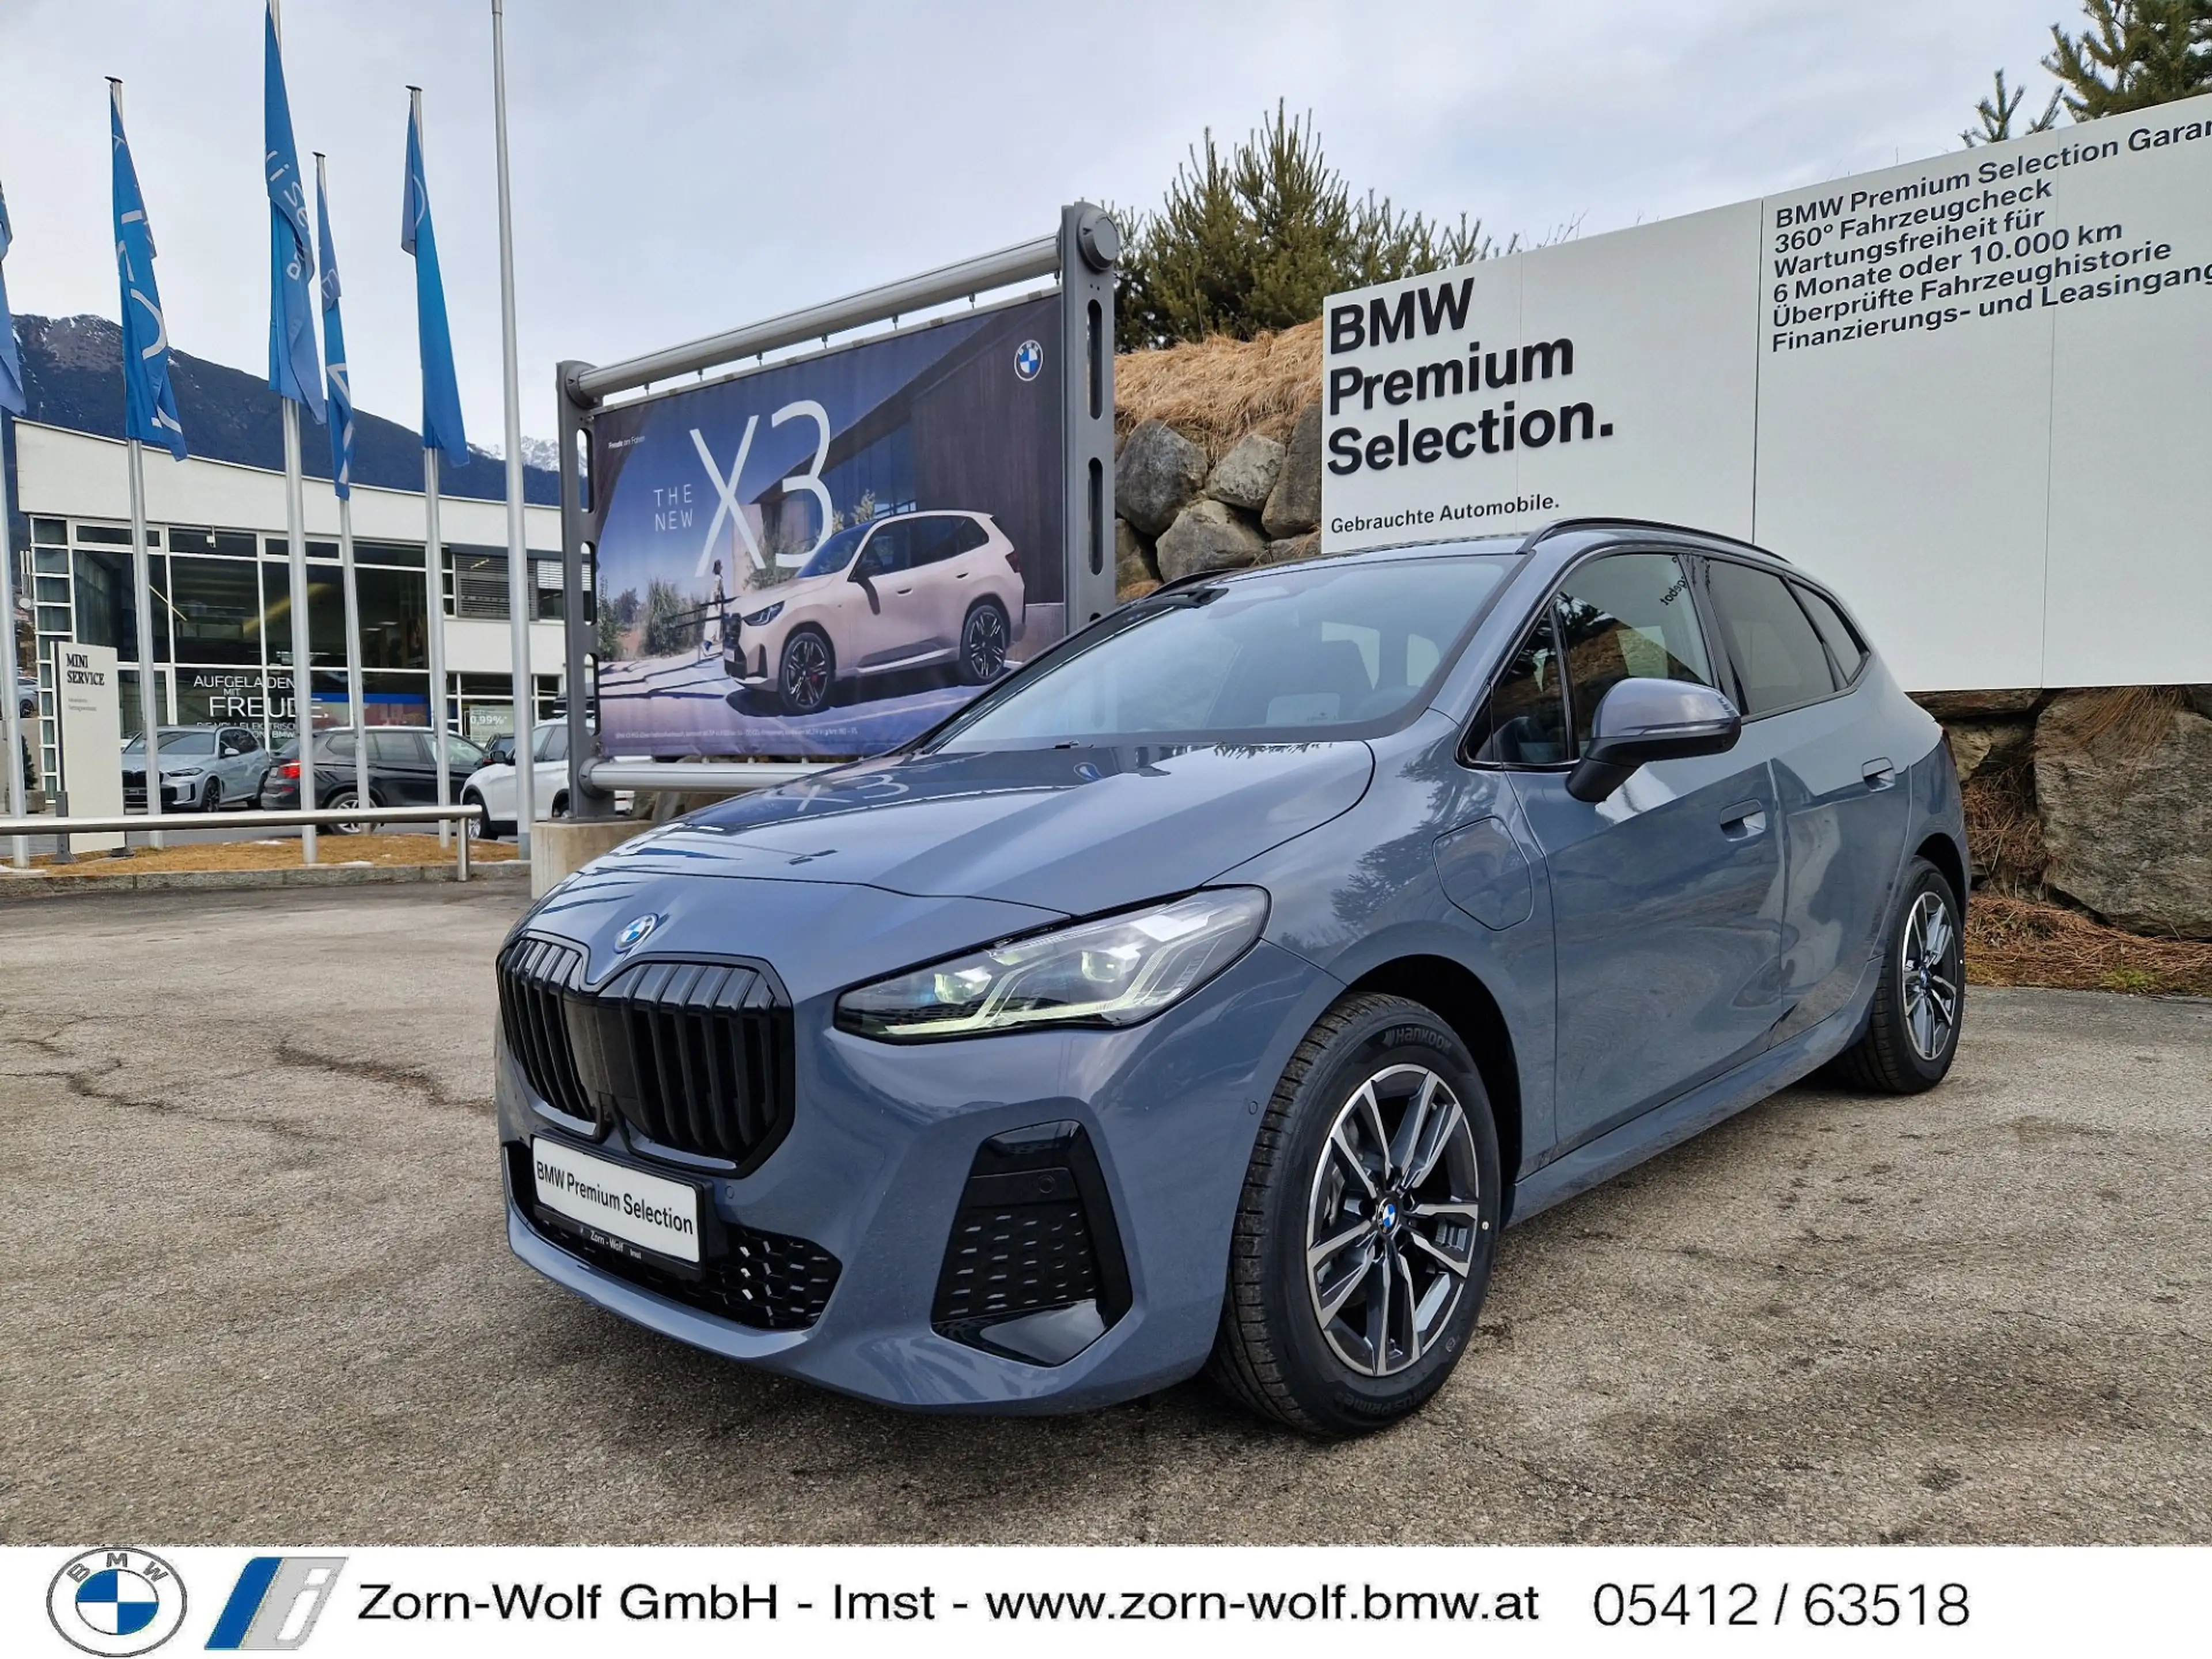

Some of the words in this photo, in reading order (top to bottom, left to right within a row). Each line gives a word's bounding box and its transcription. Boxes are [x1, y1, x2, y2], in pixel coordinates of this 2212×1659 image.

[1775, 223, 1834, 253] 360°
[1840, 178, 2053, 240] Fahrzeugcheck
[1777, 196, 1844, 229] BMW
[1851, 173, 1969, 212] Premium
[1978, 141, 2119, 184] Selection
[1774, 217, 1997, 278] Wartungsfreiheit
[2004, 209, 2045, 232] für
[1774, 283, 1788, 303] 6
[1795, 268, 1892, 299] Monate
[1899, 253, 1962, 279] oder
[1971, 229, 2069, 266] 10.000
[2078, 224, 2122, 246] km
[1330, 276, 1475, 355] BMW
[1772, 308, 1971, 353] Finanzierungs-
[1979, 289, 2032, 317] und
[1774, 288, 1913, 328] Überprüfte
[1921, 240, 2171, 301] Fahrzeughistorie
[1330, 338, 1574, 416] Premium
[1327, 401, 1613, 476] Selection.
[653, 483, 692, 507] THE
[655, 507, 693, 532] NEW
[689, 400, 834, 578] X3
[1331, 509, 1434, 533] Gebrauchte
[1440, 493, 1559, 522] Automobile.
[66, 653, 88, 668] MINI
[67, 670, 105, 685] SERVICE
[223, 688, 241, 696] MIT
[536, 1160, 565, 1191] BMW
[566, 1172, 620, 1211] Premium
[623, 1192, 694, 1236] Selection
